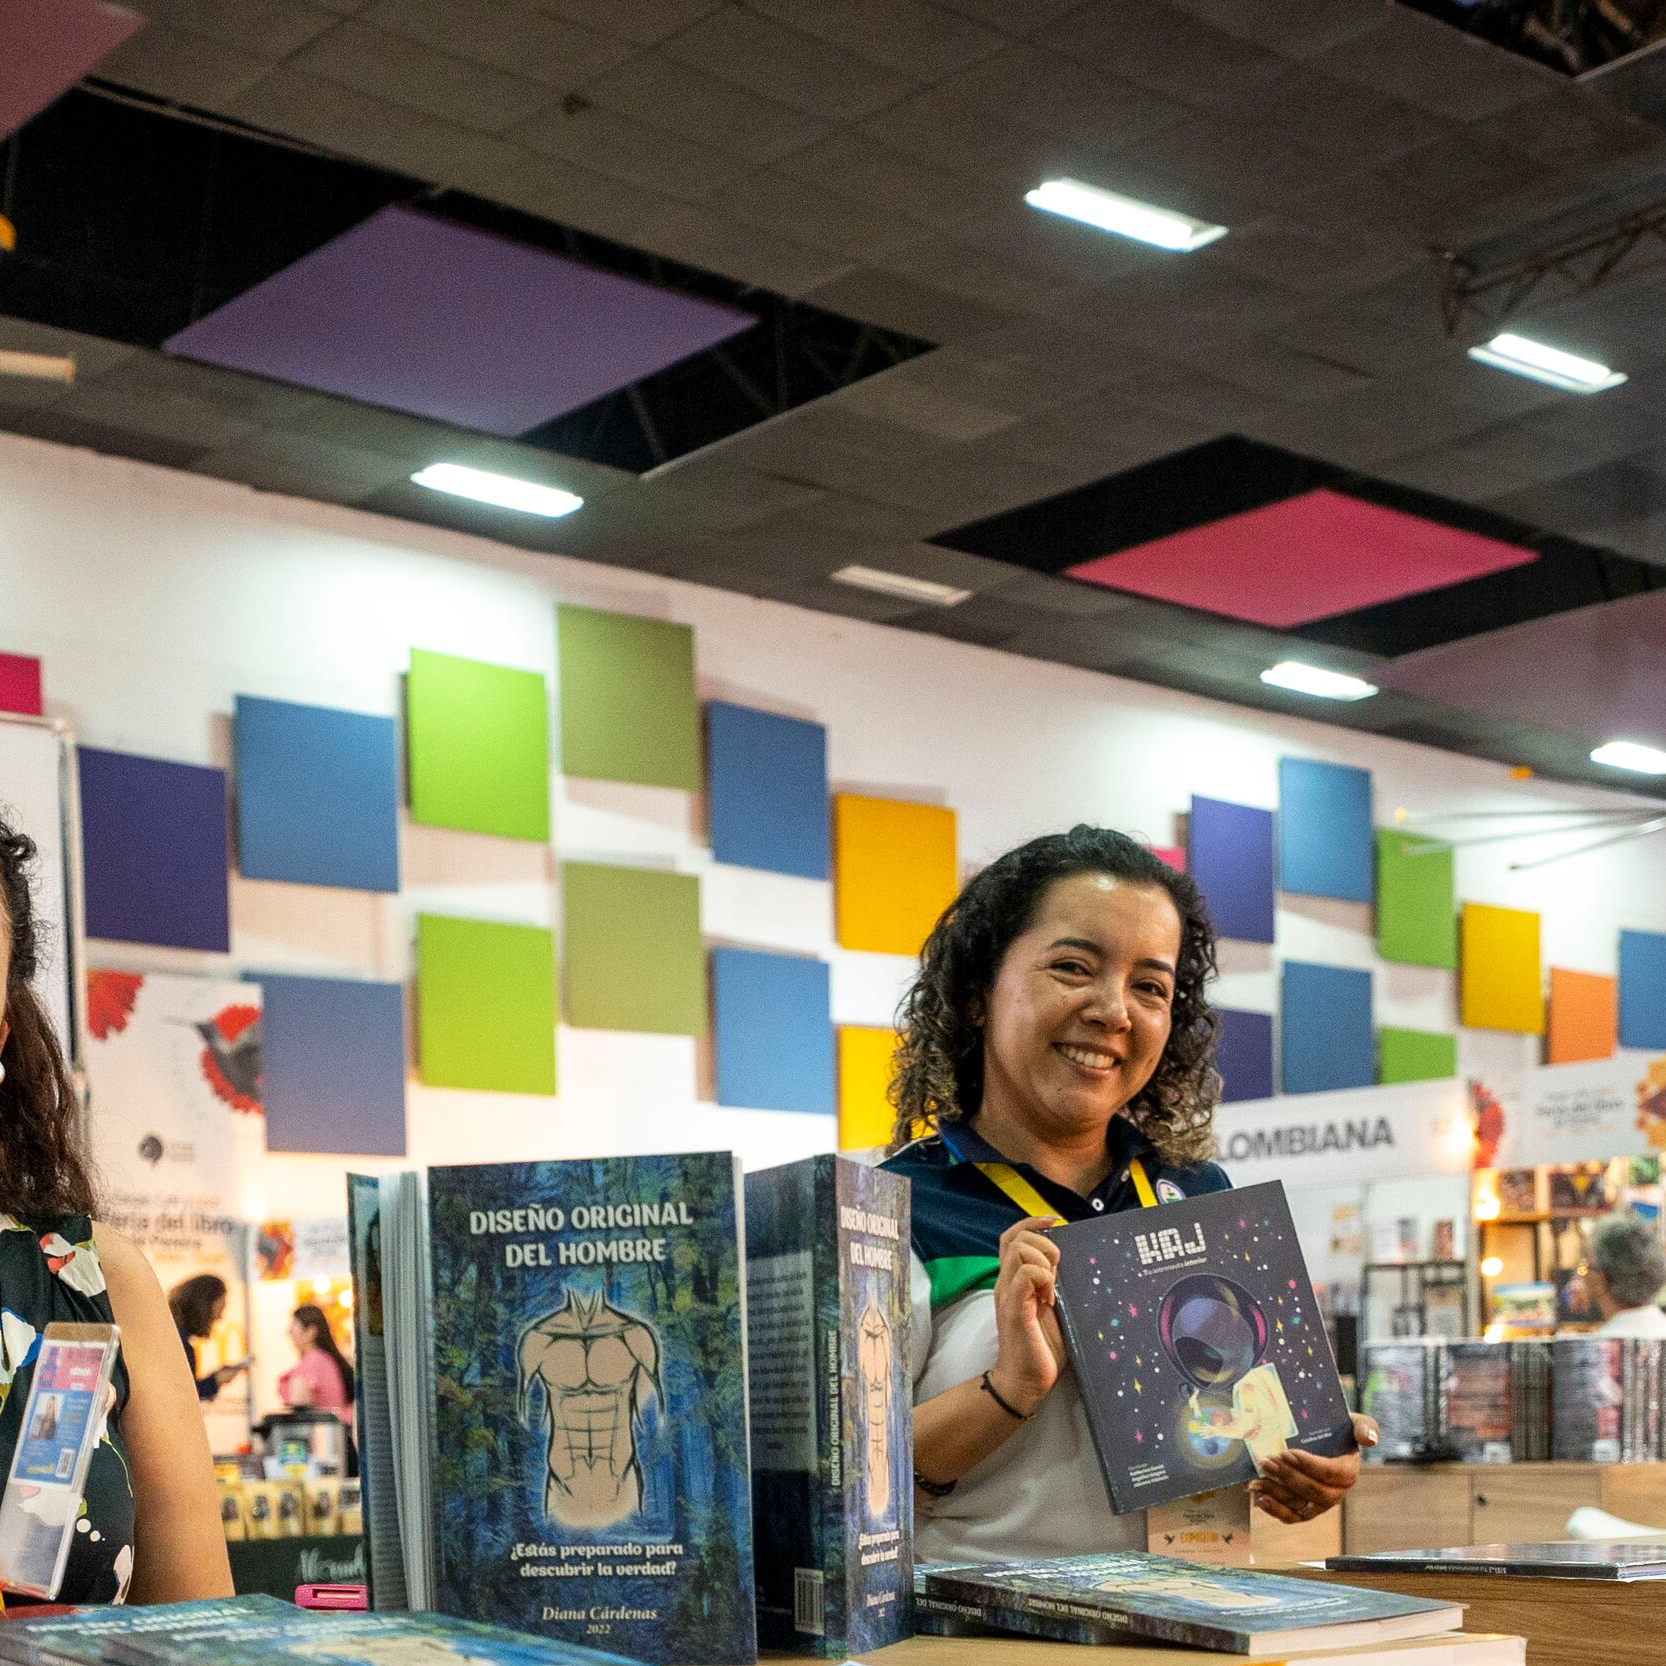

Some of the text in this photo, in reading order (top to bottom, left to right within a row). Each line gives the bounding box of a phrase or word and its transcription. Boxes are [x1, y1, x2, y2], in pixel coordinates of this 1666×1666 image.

[470, 1201, 694, 1235] DISEÑO ORIGINAL
[841, 1204, 899, 1240] DISEÑO ORIGINAL
[506, 1238, 667, 1268] DEL HOMBRE
[850, 1242, 892, 1271] DEL HOMBRE
[829, 1374, 838, 1394] DEL
[830, 1396, 839, 1446] ORIGINAL
[511, 1542, 684, 1560] ¿Estás preparado para
[520, 1561, 677, 1577] descubrir la verdad?
[542, 1605, 658, 1621] Diana Cárdenas
[586, 1623, 611, 1634] 2022
